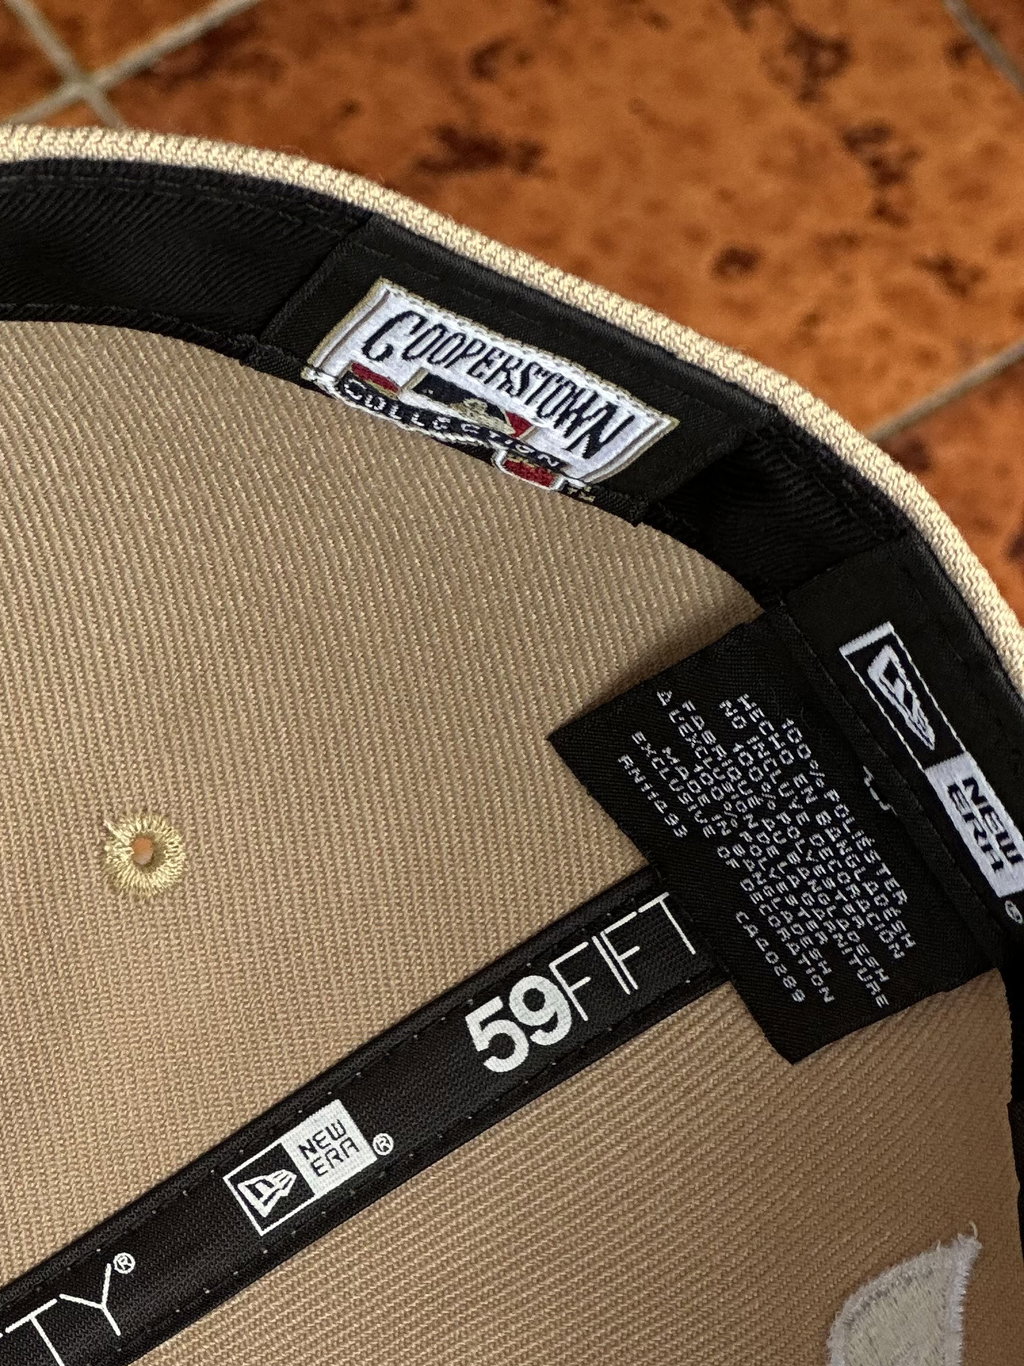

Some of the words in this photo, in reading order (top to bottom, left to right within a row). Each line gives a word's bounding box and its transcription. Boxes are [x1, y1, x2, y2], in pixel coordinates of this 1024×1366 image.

[360, 309, 636, 459] COOPERSTOWN
[719, 699, 748, 730] NO
[746, 735, 811, 826] INCLUYE
[736, 693, 795, 765] HECHO
[792, 773, 819, 804] EN
[631, 731, 717, 839] EXCLUSIVE
[716, 846, 741, 869] OF
[739, 878, 835, 1003] DECORATION
[661, 746, 711, 807] MADE
[711, 814, 732, 836] IN
[732, 843, 832, 975] BANGLADESH
[775, 811, 865, 929] POLYESTER
[947, 783, 1004, 872] ERA
[962, 777, 1024, 866] NEW
[738, 830, 829, 945] POLYESTER
[755, 831, 780, 858] DE
[776, 861, 801, 889] LA
[800, 891, 889, 1008] GARNITURE
[761, 818, 787, 845] AU
[786, 850, 890, 982] BANGLADESH
[298, 1119, 346, 1160] NEW
[310, 1137, 360, 1177] ERA
